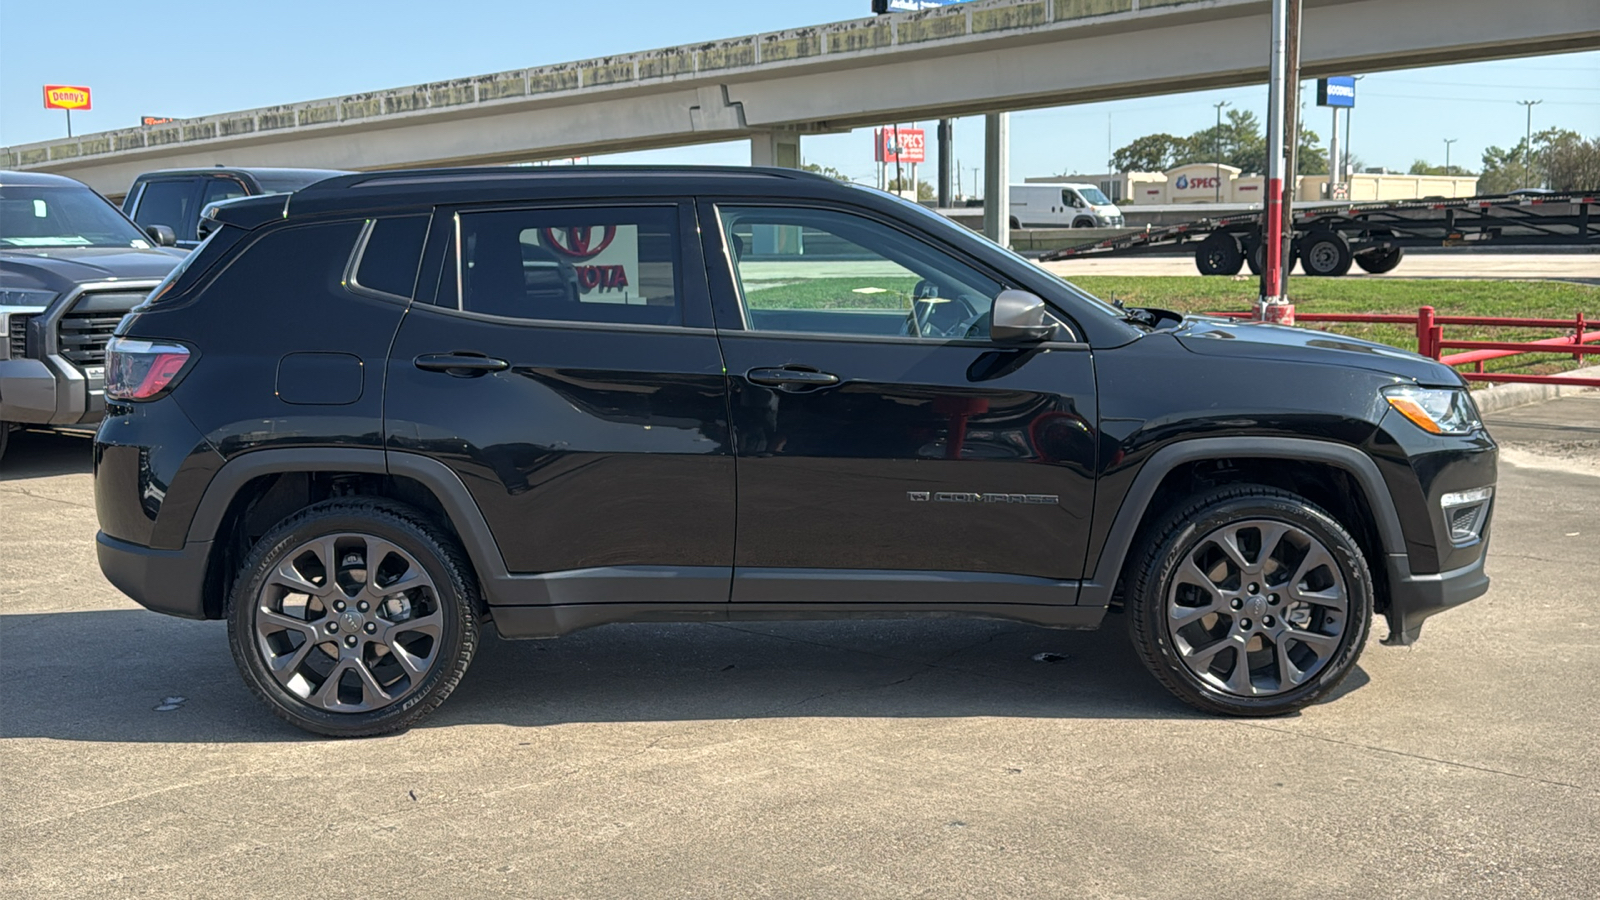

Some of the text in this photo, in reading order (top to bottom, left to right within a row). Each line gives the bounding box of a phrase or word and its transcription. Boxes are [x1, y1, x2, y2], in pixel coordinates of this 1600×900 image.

[1327, 84, 1354, 98] GOODWILL
[53, 92, 84, 103] Denny's
[935, 492, 1059, 504] COMPASS
